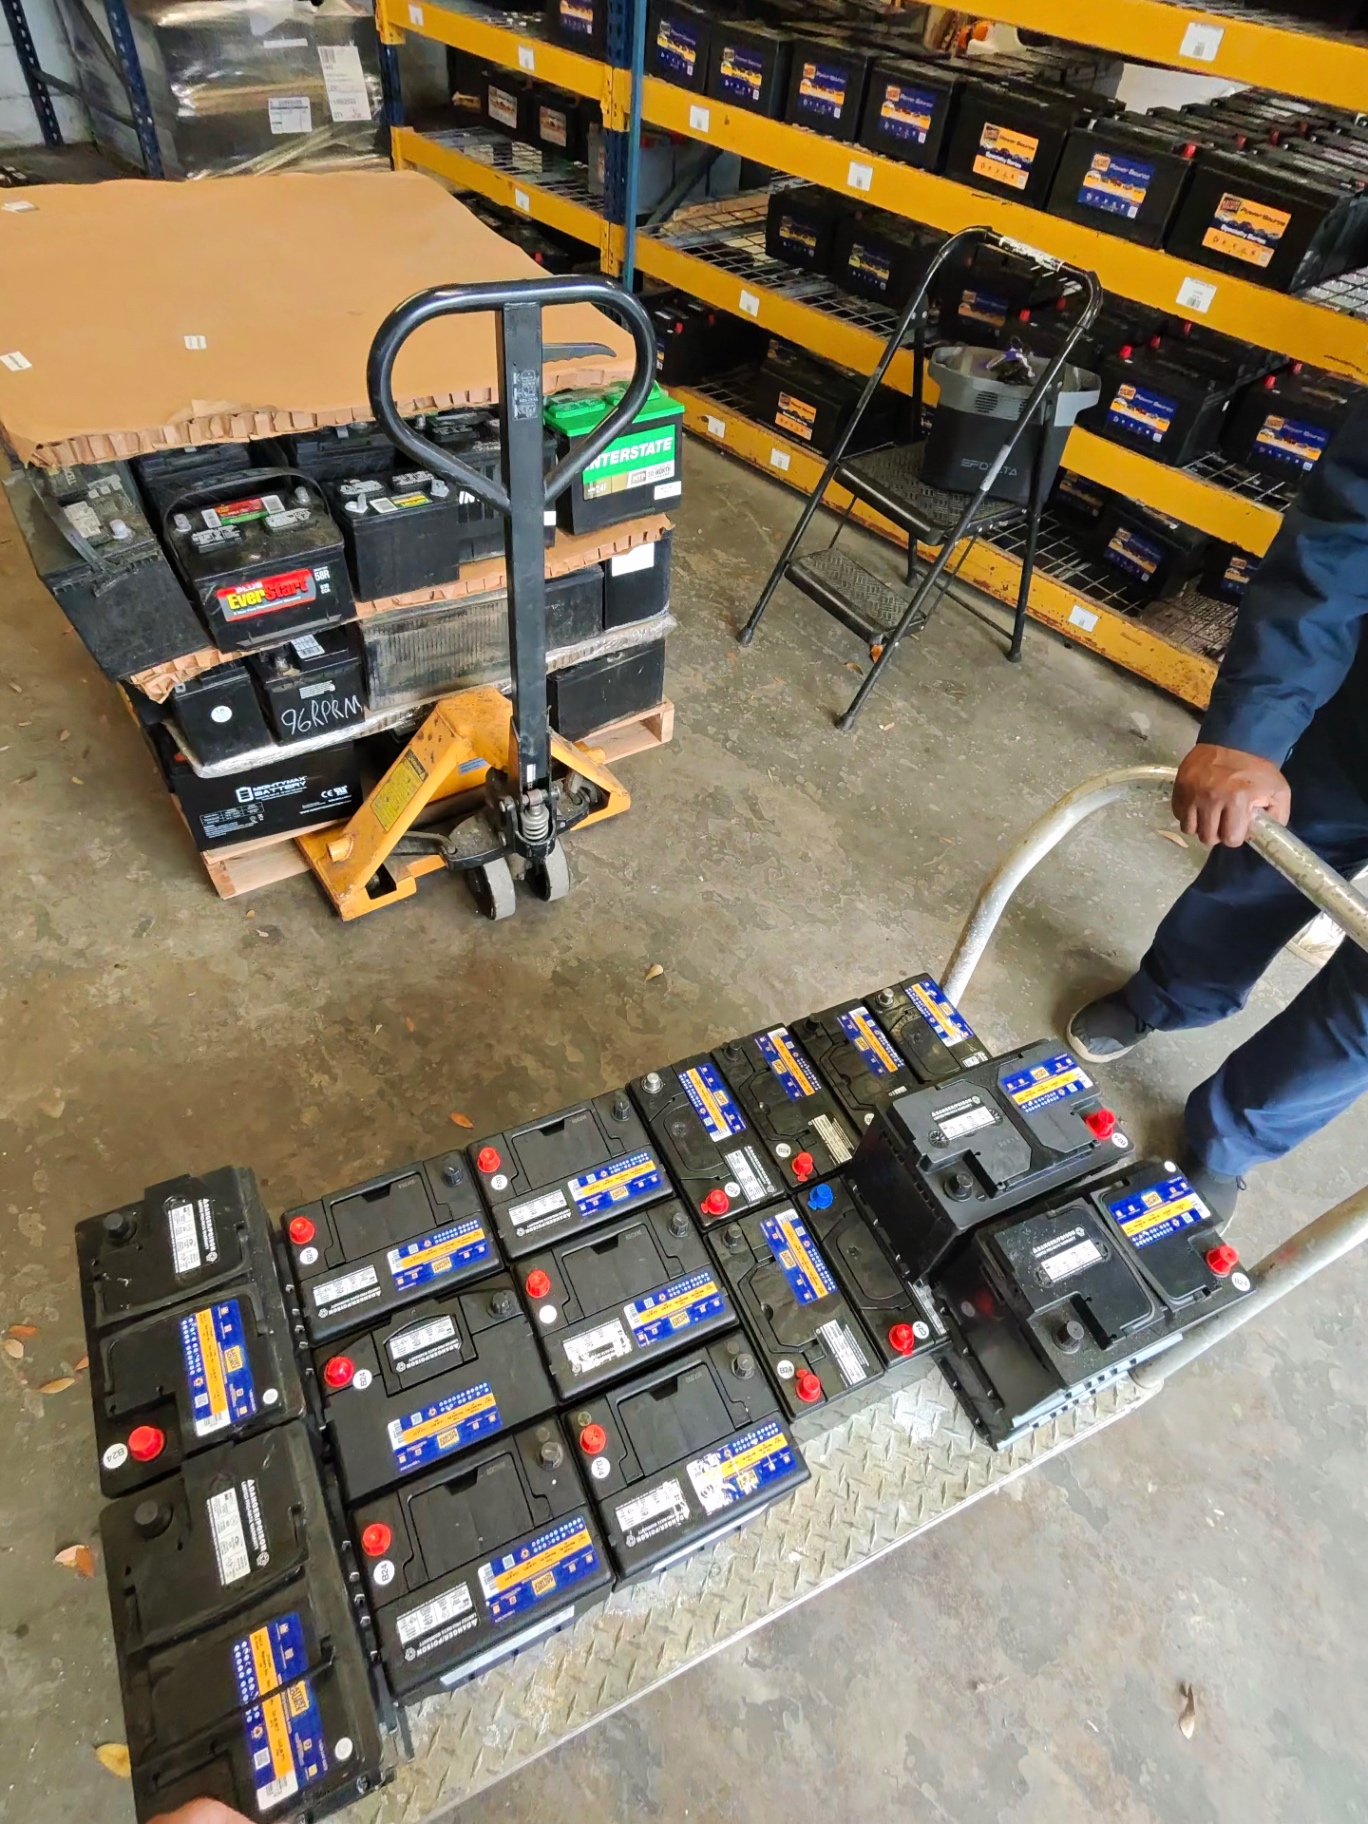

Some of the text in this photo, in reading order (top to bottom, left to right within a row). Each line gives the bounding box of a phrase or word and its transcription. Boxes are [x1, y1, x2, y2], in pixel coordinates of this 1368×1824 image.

[1108, 162, 1151, 181] Power Source
[1239, 206, 1286, 227] Power Source
[1134, 392, 1174, 413] Power Source
[586, 437, 673, 471] NTERSTATE
[961, 458, 1017, 476] EFDTA
[314, 569, 331, 581] 58R
[227, 575, 309, 610] EverStart
[235, 581, 263, 594] PLUS
[254, 780, 307, 797] BATTERY
[780, 1364, 793, 1374] B24
[360, 1372, 368, 1386] B24
[107, 1448, 125, 1463] B24
[246, 1485, 267, 1552] DANGER/POISON
[381, 1562, 390, 1582] B24
[414, 1620, 473, 1657] DANGER/POISON
